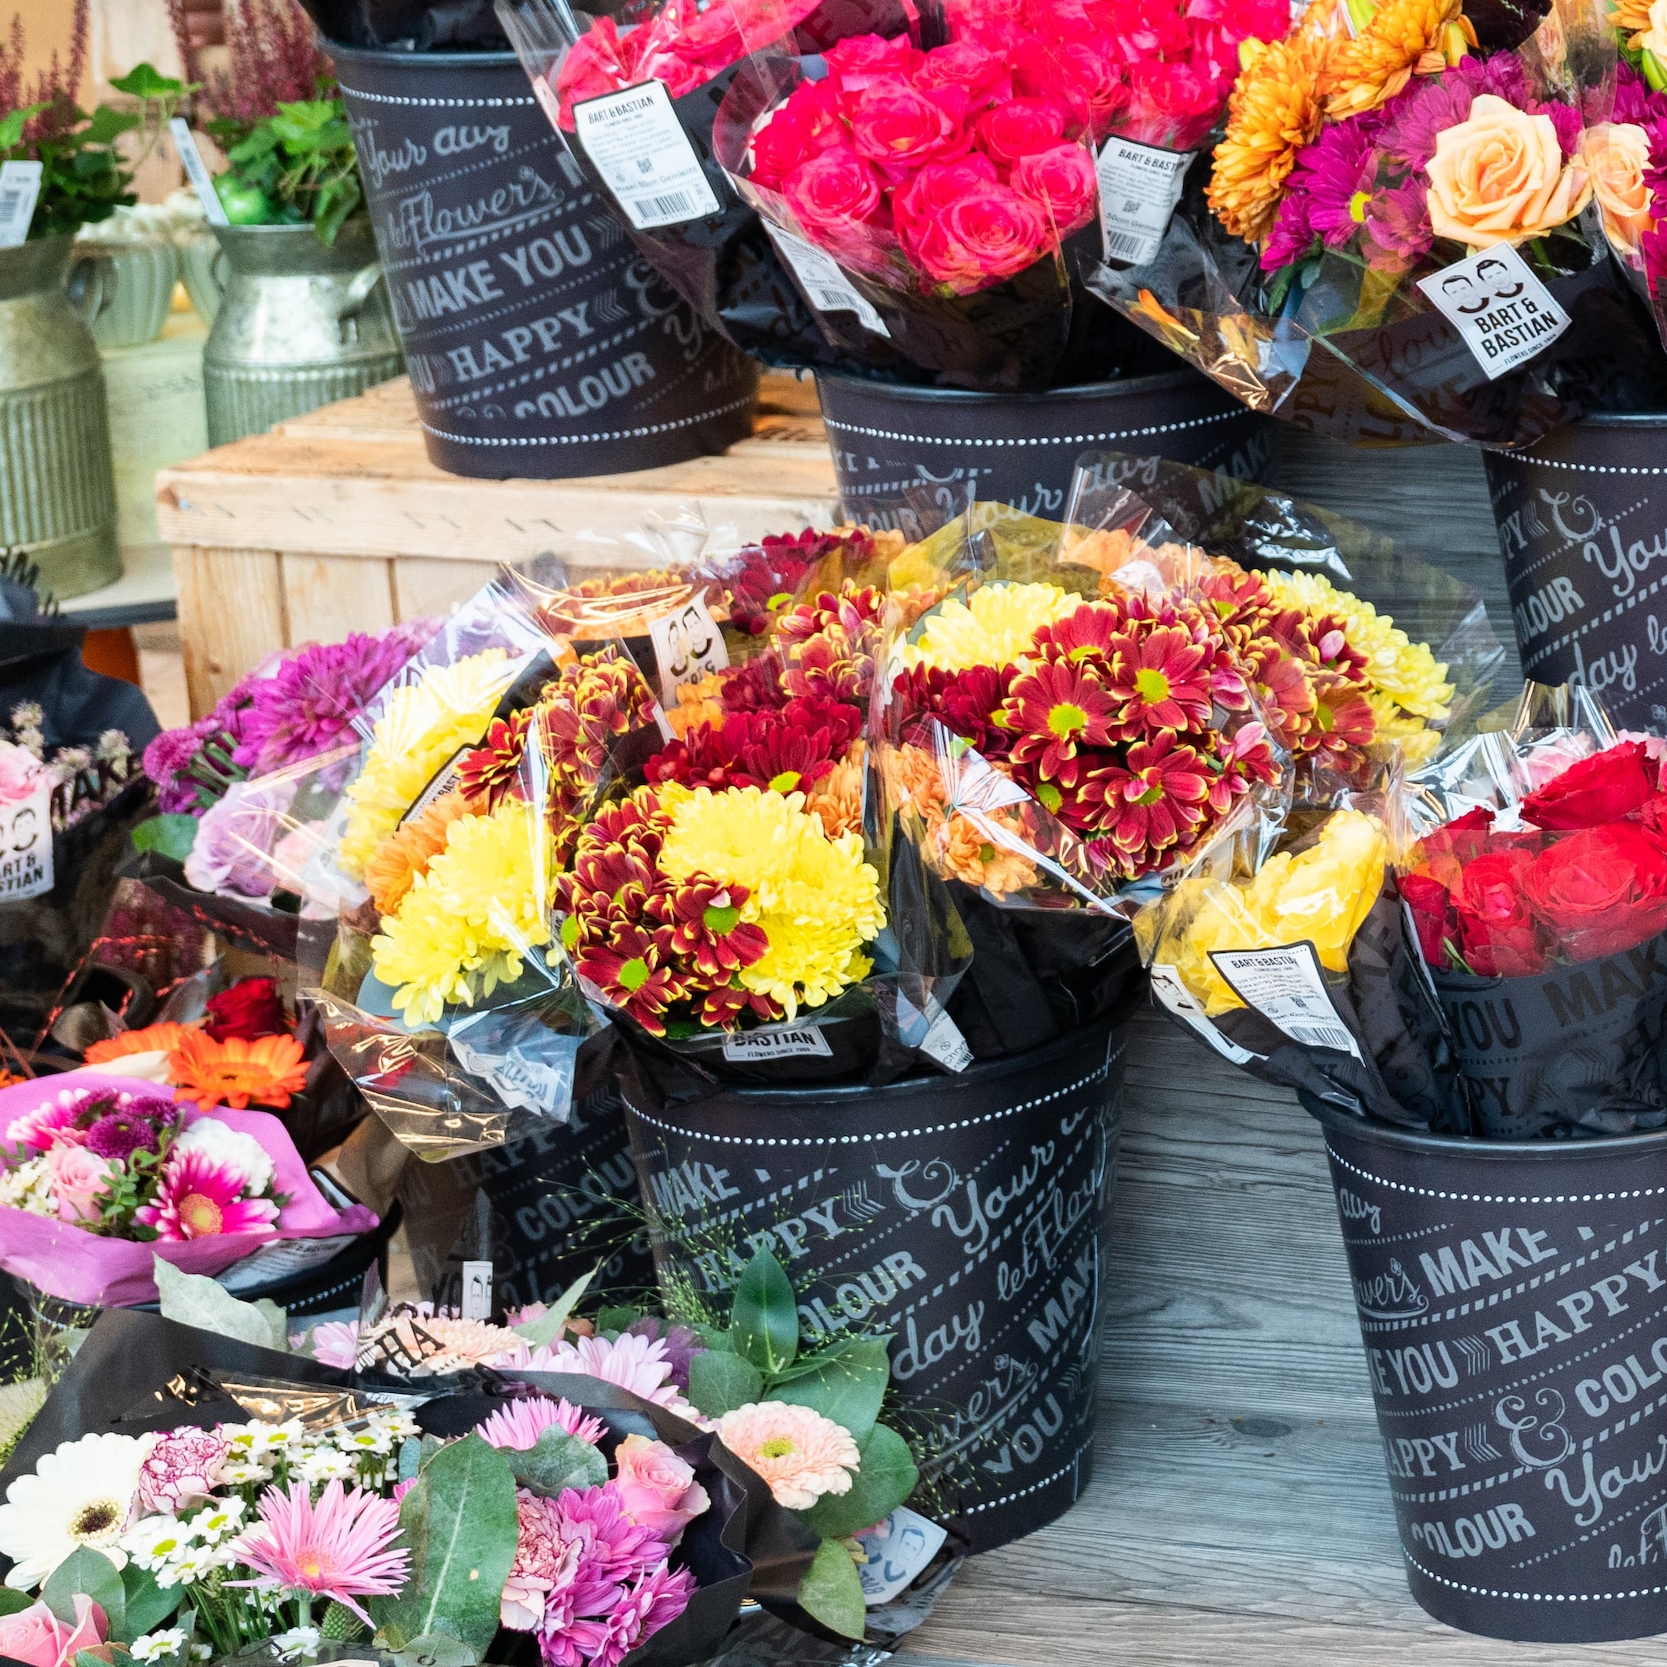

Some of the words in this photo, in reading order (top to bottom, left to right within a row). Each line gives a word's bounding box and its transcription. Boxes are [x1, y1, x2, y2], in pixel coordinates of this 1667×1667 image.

[589, 111, 607, 124] BART
[616, 95, 655, 116] BASTIAN
[362, 140, 426, 196] Your
[659, 166, 698, 183] Gemischt
[411, 259, 498, 318] MAKE
[500, 221, 593, 287] YOU
[449, 304, 596, 382] HAPPY
[1474, 305, 1522, 333] BART
[1523, 299, 1538, 316] &
[1479, 310, 1560, 361] BASTIAN
[514, 351, 656, 418] COLOUR
[1568, 641, 1639, 701] day
[1231, 959, 1255, 969] BART
[1256, 958, 1264, 966] &
[733, 1031, 817, 1050] BASTIAN
[747, 1049, 779, 1059] FLOWERS
[651, 1166, 742, 1217] MAKE
[930, 1140, 1056, 1255] Your
[1419, 1225, 1559, 1300] MAKE
[893, 1298, 986, 1383] day
[997, 1258, 1037, 1304] let
[1390, 1340, 1458, 1394] YOU
[1482, 1249, 1667, 1365] HAPPY
[984, 1393, 1066, 1475] YOU
[1492, 1386, 1575, 1471] &
